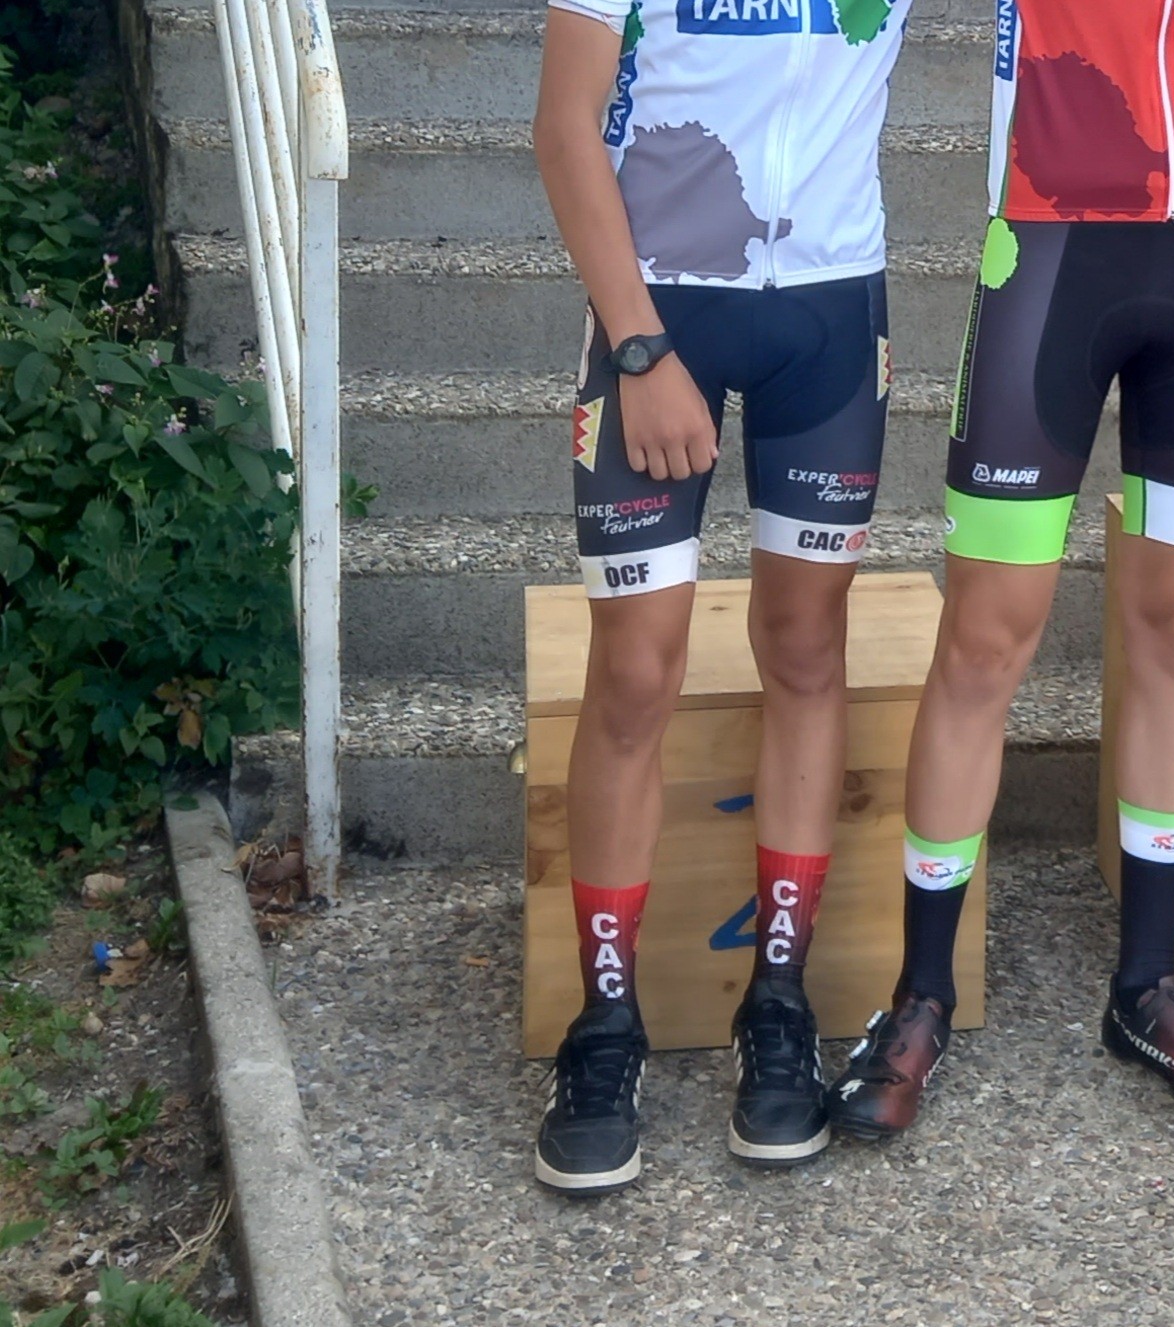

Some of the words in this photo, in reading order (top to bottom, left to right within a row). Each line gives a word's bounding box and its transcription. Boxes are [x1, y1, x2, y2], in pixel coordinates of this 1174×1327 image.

[992, 468, 1040, 484] MAPEI
[797, 530, 846, 552] CAC
[604, 562, 650, 589] OCF
[766, 879, 799, 964] CAC
[591, 913, 625, 999] CAC
